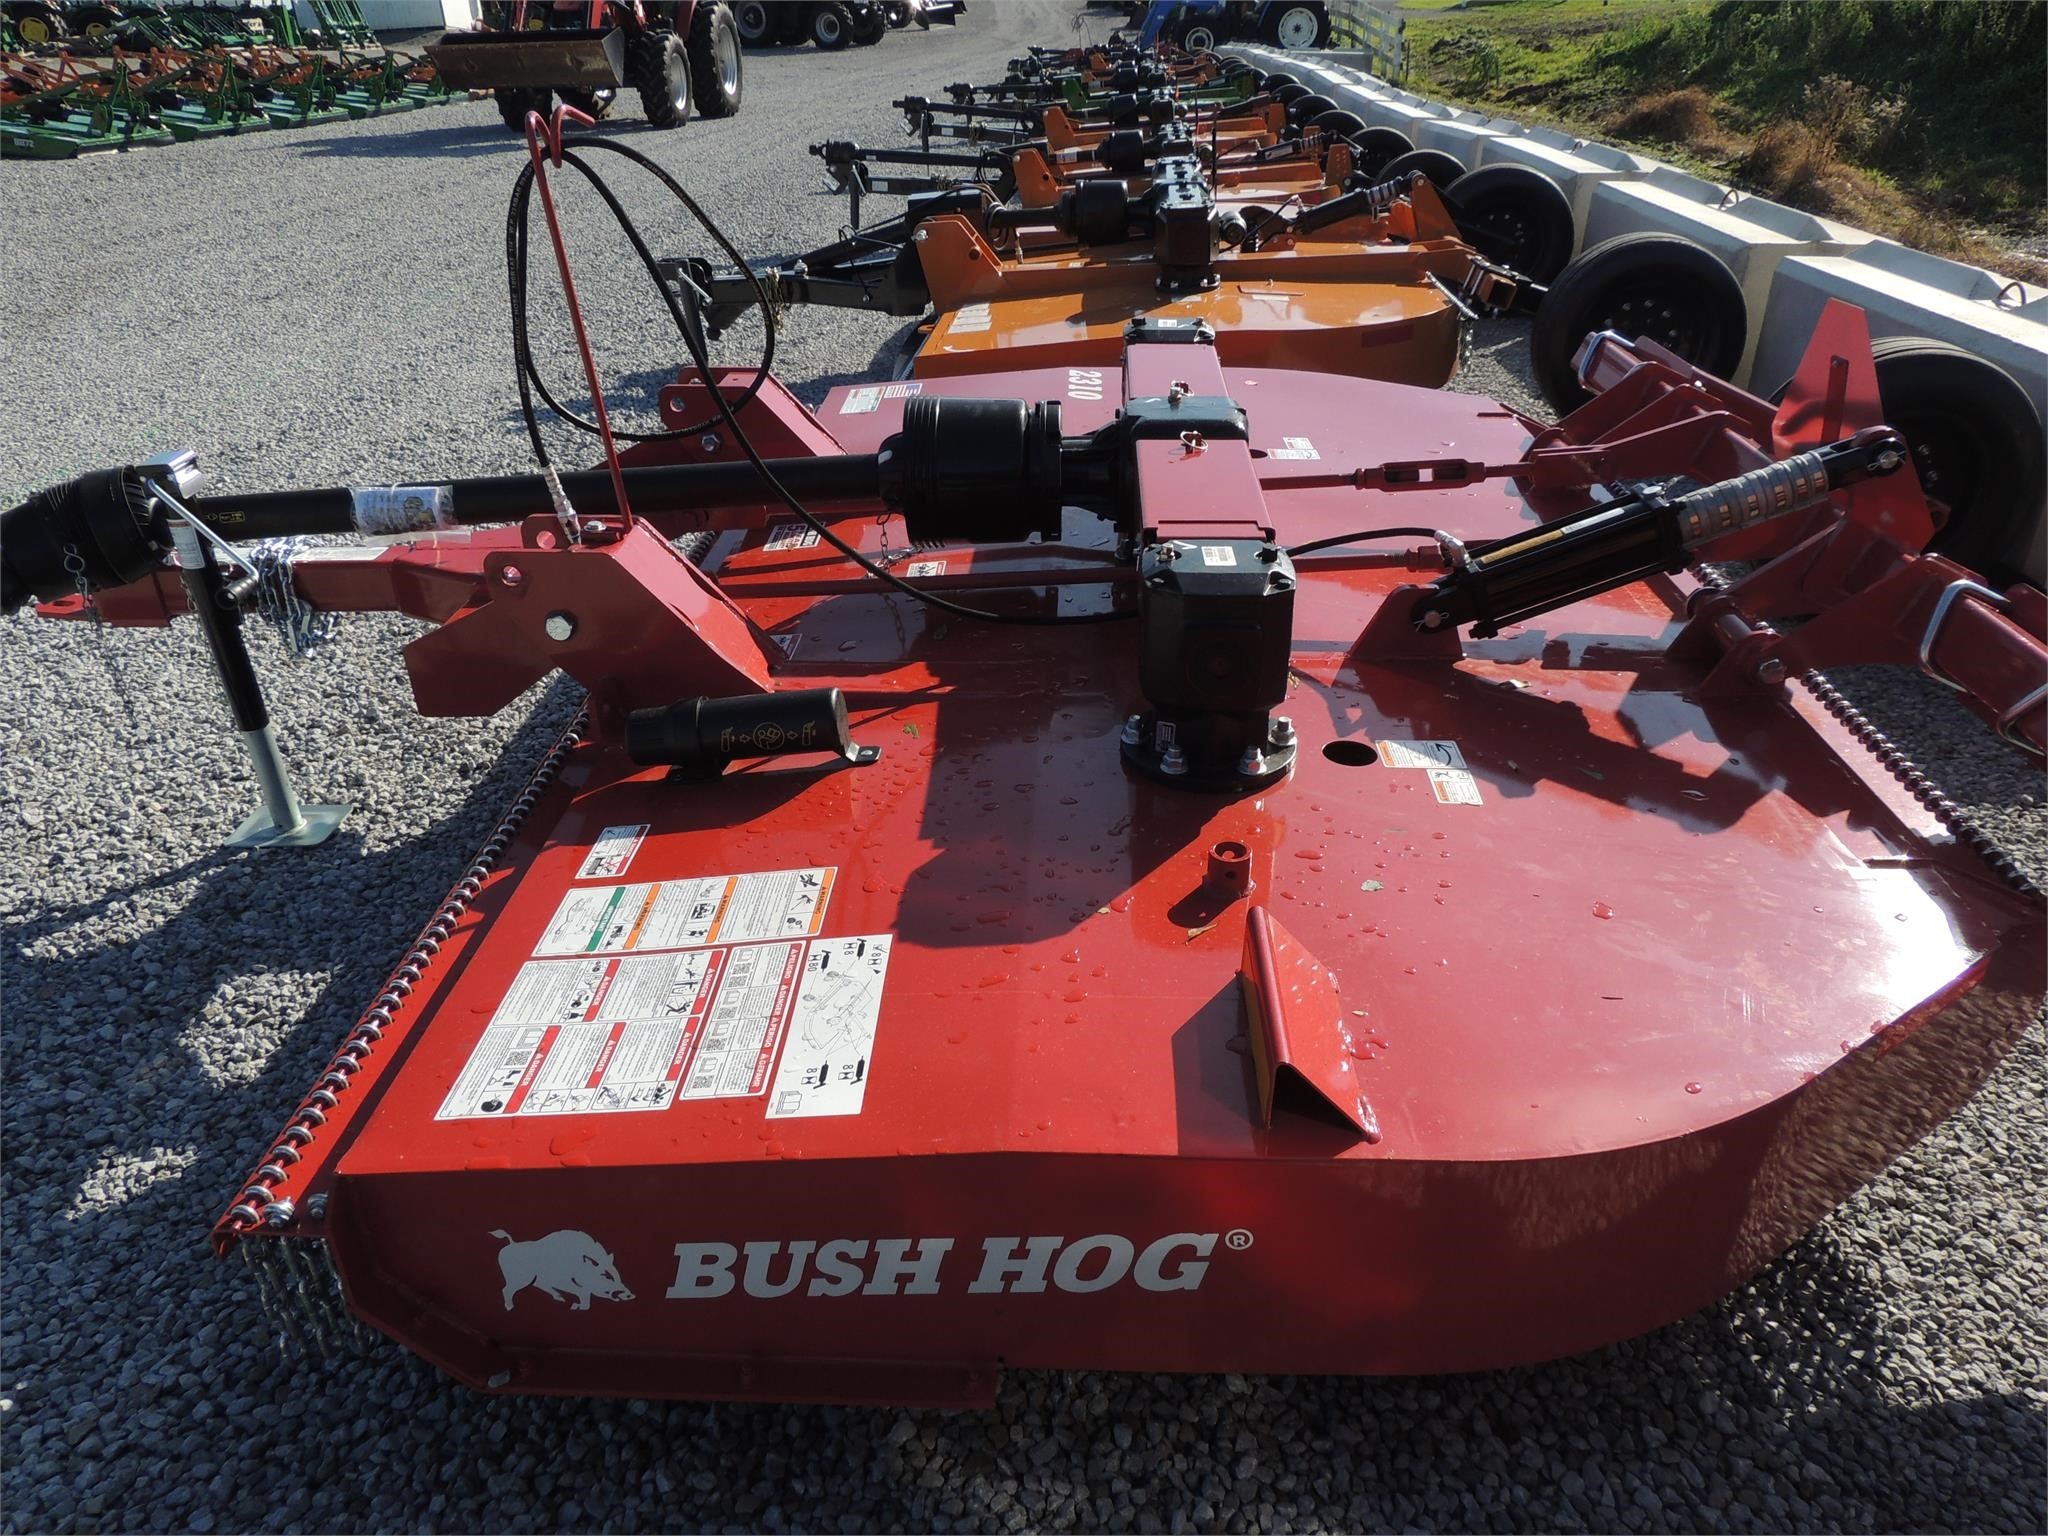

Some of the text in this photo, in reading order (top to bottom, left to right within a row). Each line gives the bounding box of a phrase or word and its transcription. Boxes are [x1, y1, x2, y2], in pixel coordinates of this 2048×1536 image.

[1067, 369, 1103, 400] 2310
[713, 898, 729, 923] WARNING
[814, 889, 827, 914] WARNING
[784, 953, 798, 979] PELIGRO
[807, 962, 819, 972] 80
[591, 981, 608, 1006] DANGER
[698, 973, 714, 999] DANGER
[772, 989, 787, 1016] DANGER
[763, 1021, 778, 1048] PERIGO
[594, 1046, 613, 1073] DANGER
[673, 1038, 690, 1065] DANGER
[520, 1057, 541, 1087] DANGER
[751, 1059, 767, 1088] GEFAHR
[665, 1233, 1220, 1299] BUSH HOG
